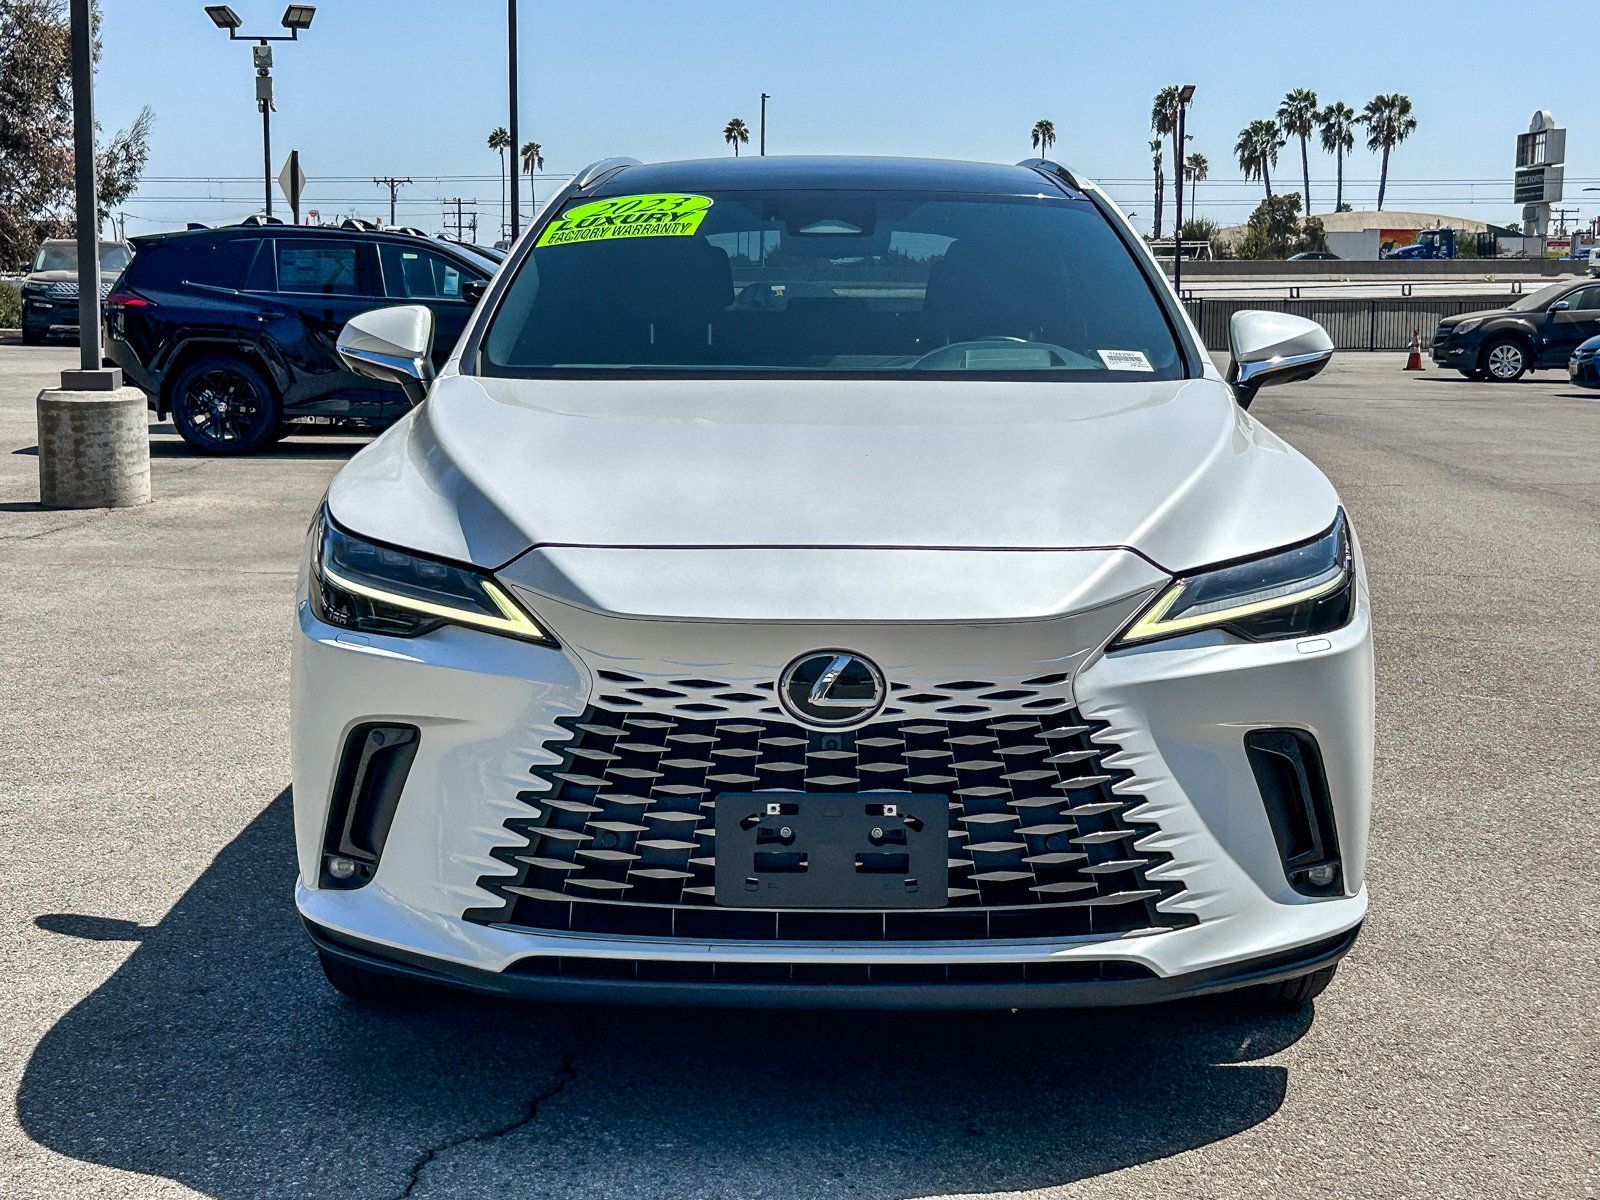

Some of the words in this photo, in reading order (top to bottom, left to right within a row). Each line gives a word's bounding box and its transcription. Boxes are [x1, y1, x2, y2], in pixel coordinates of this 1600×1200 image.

[588, 197, 692, 216] 2023
[555, 211, 695, 232] LUXURY
[548, 226, 611, 244] FACTORY
[613, 223, 692, 236] WARRANTY
